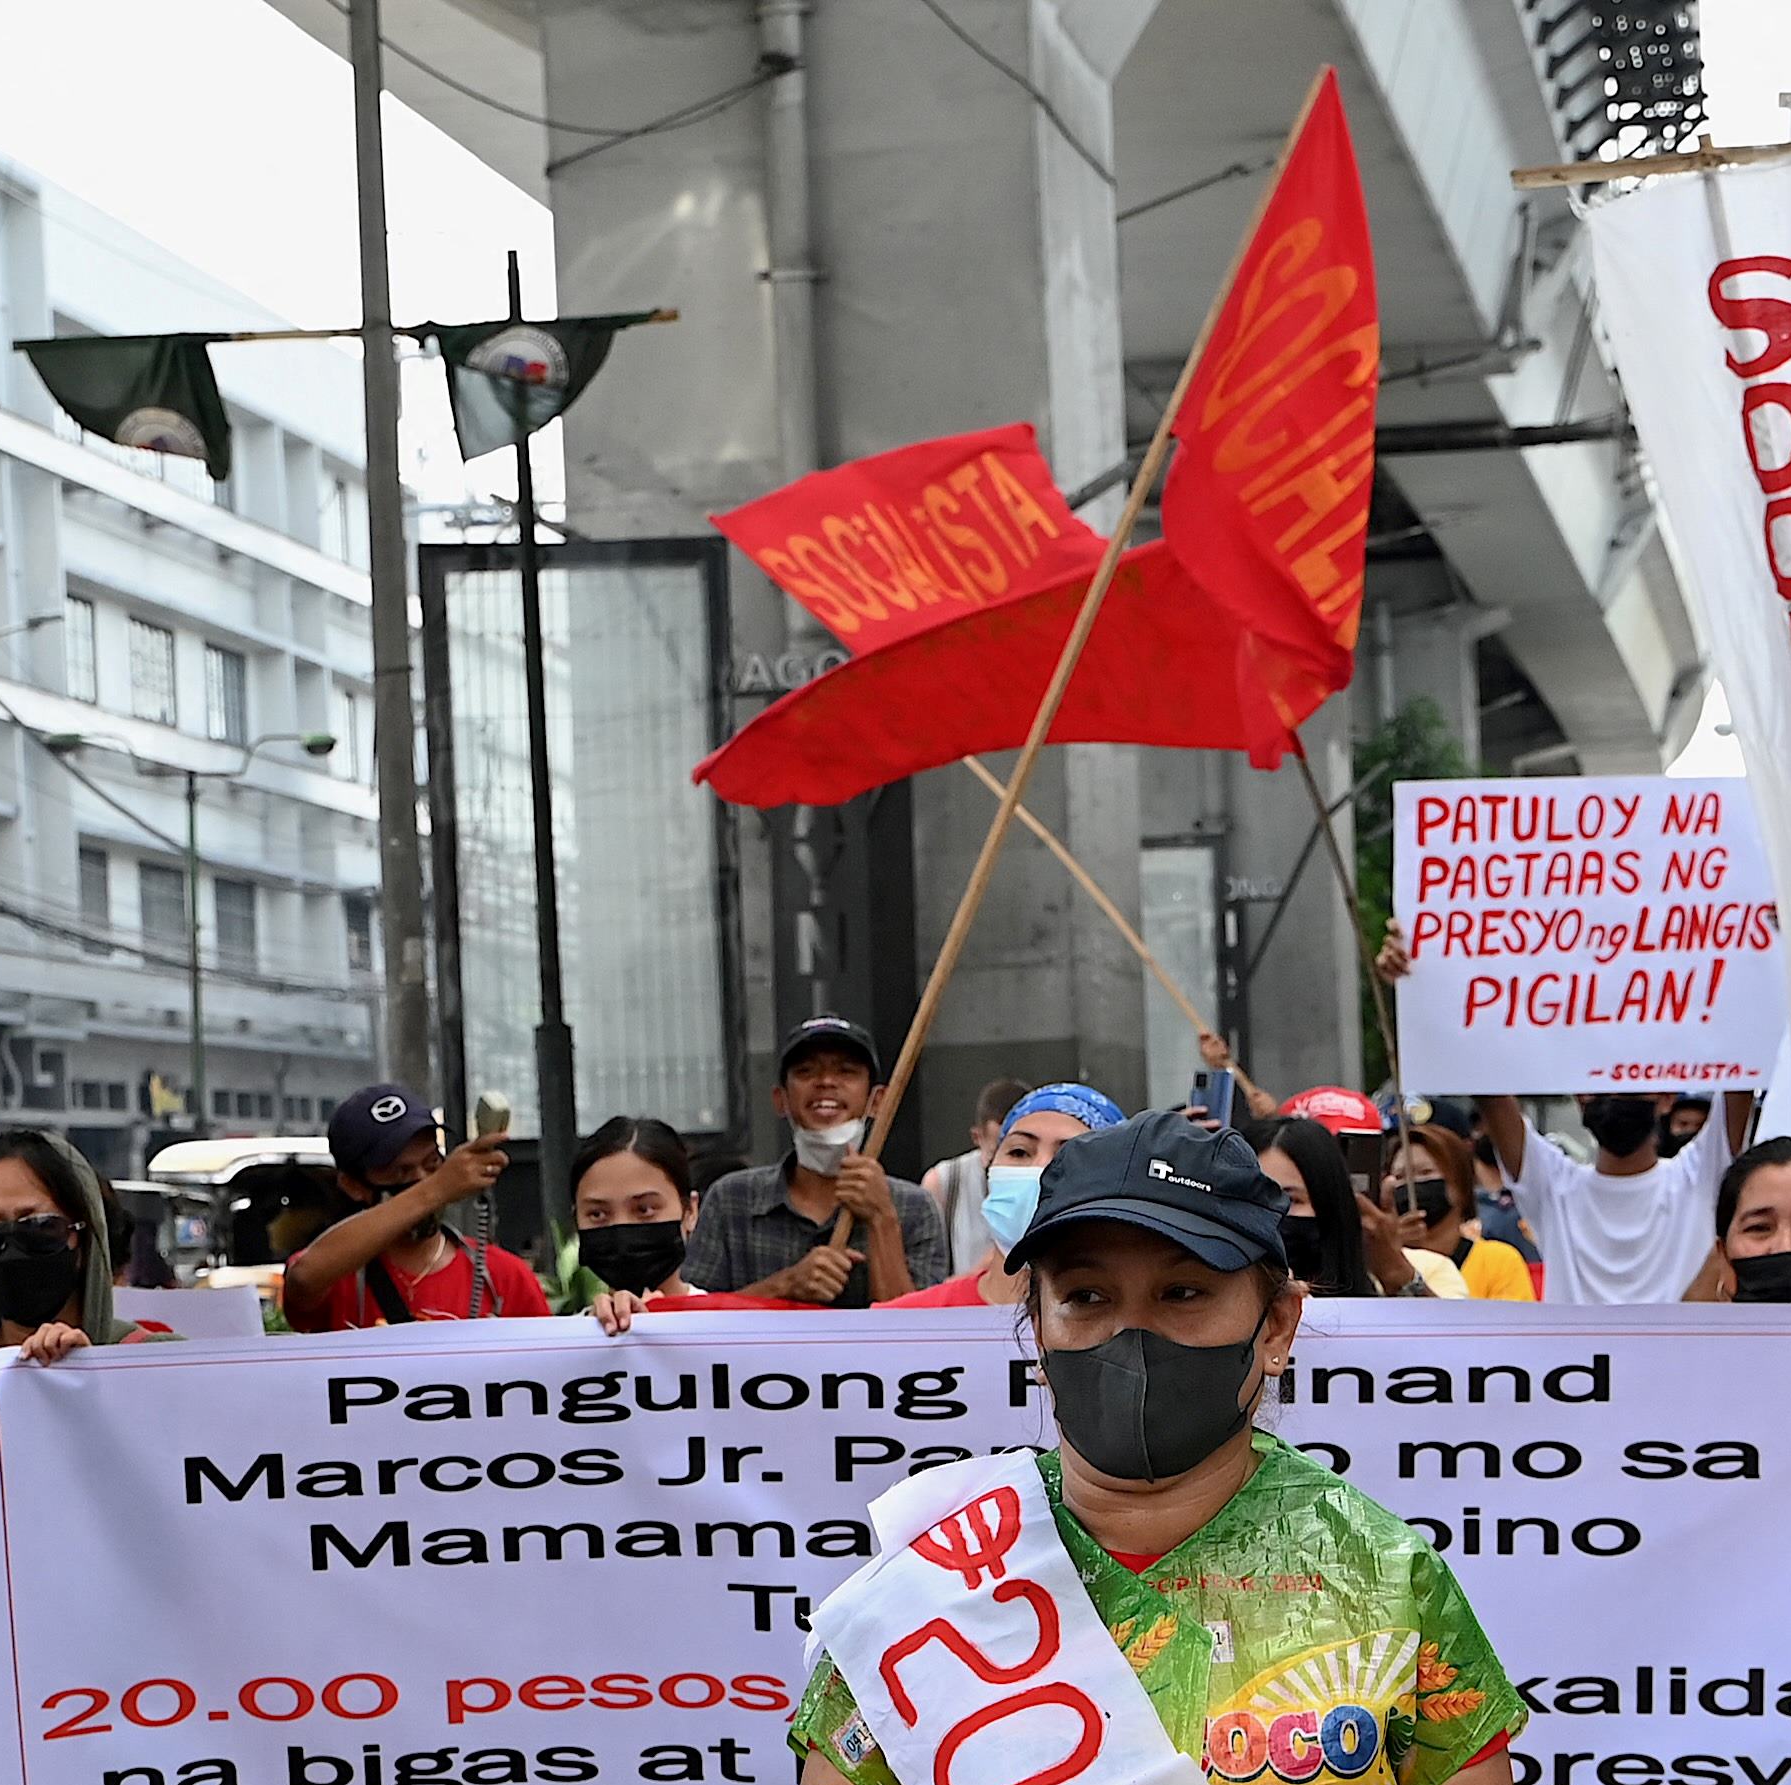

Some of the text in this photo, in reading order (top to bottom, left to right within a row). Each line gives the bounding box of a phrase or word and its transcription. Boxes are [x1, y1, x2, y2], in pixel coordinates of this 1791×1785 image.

[759, 451, 1060, 634] SOCIALISTA
[1417, 792, 1722, 847] PATULOY NA
[1417, 847, 1728, 903] PAGTAAS NG
[1411, 902, 1774, 964] PRESYO ng LANGIS
[1463, 958, 1726, 1029] PIGILAN!
[1167, 1175, 1212, 1193] outdoors
[327, 1353, 1611, 1426] Pangulong Finand
[182, 1446, 626, 1507] Marcos
[657, 1435, 784, 1488] Jr.
[1398, 1440, 1583, 1480] mo
[1620, 1440, 1761, 1480] sa
[308, 1519, 873, 1572] Mamama
[39, 1671, 400, 1742] 20.00
[638, 1735, 758, 1785] at
[1201, 1704, 1379, 1784] OCO
